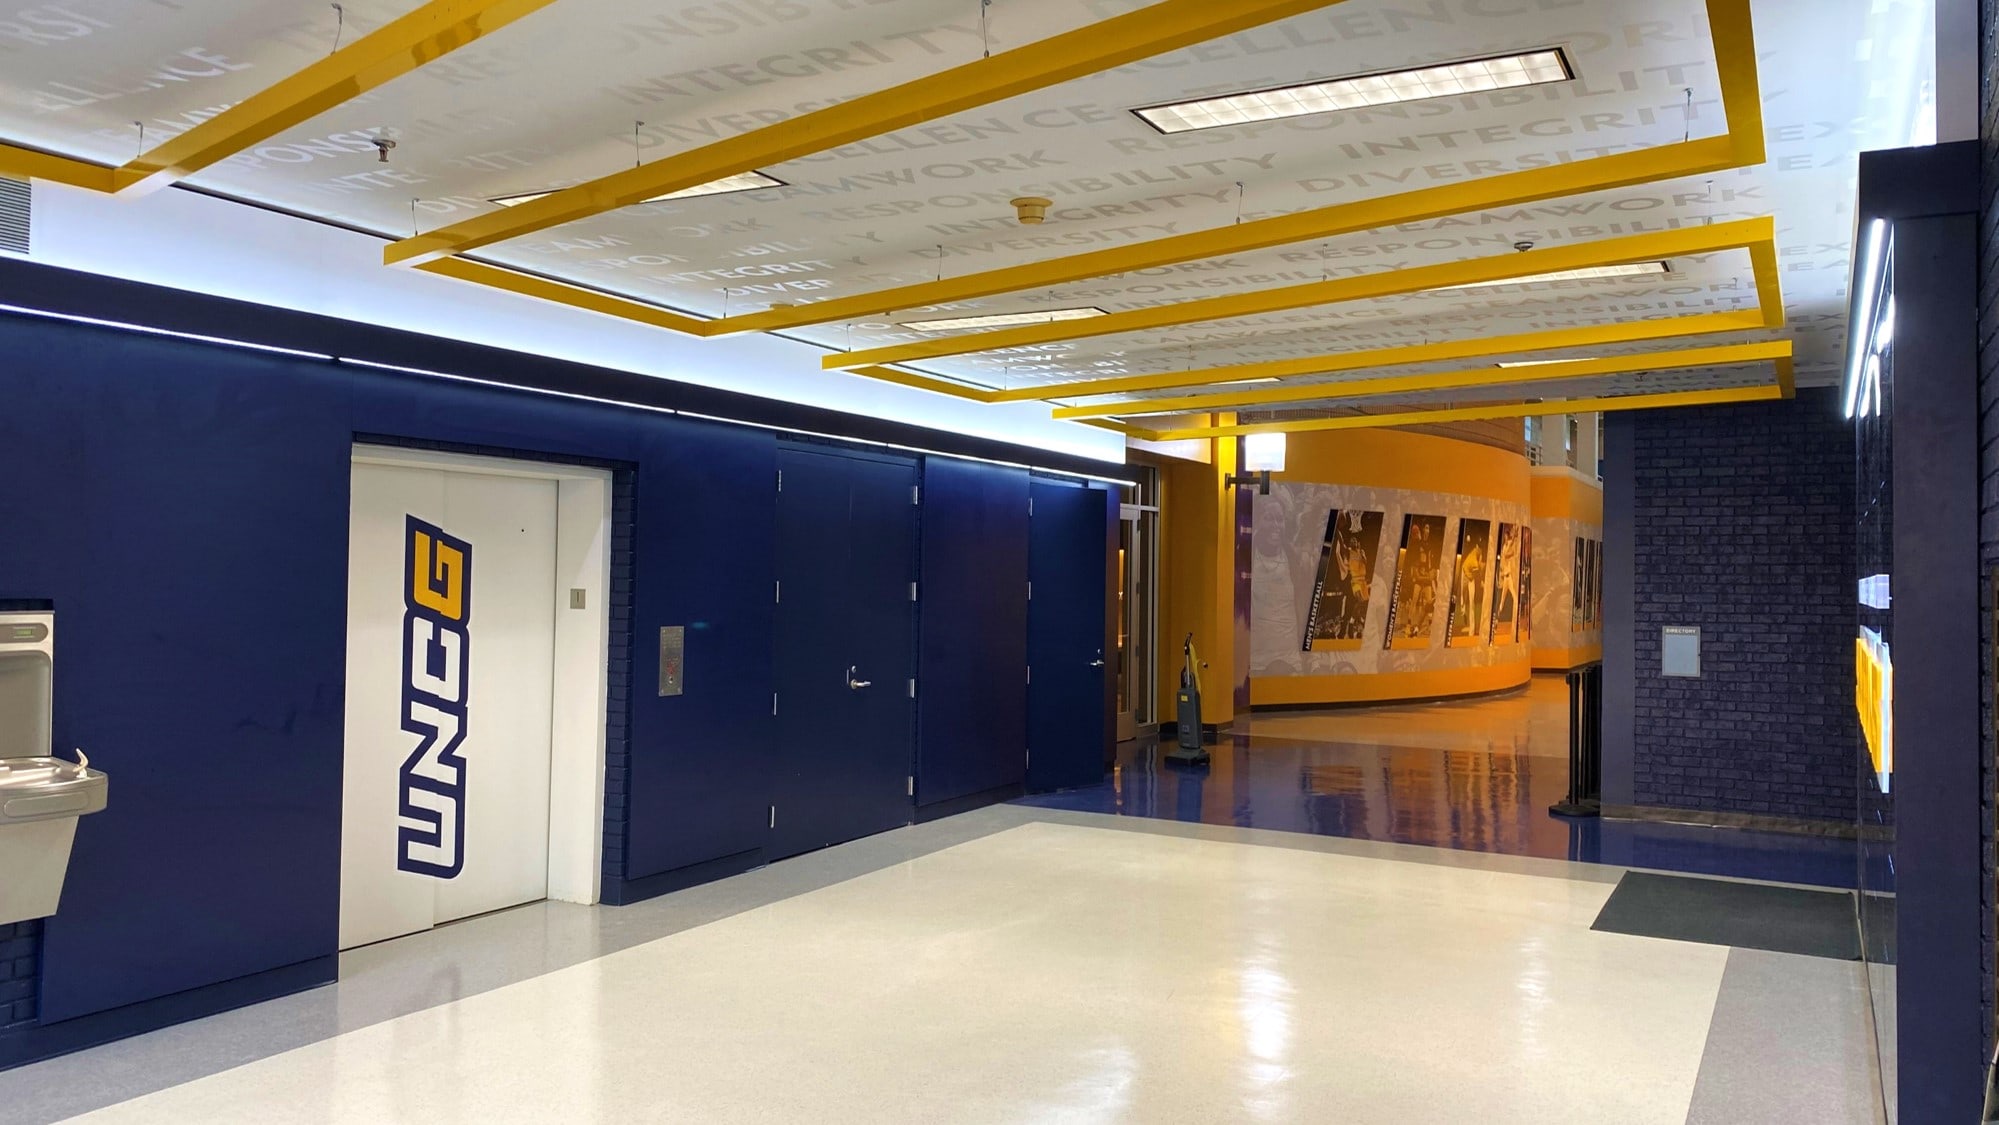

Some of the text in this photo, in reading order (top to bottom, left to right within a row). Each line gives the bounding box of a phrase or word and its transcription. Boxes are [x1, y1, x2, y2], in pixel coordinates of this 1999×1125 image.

[397, 513, 472, 880] UNCG
[1305, 581, 1323, 650] MEN'S BASKETBALL
